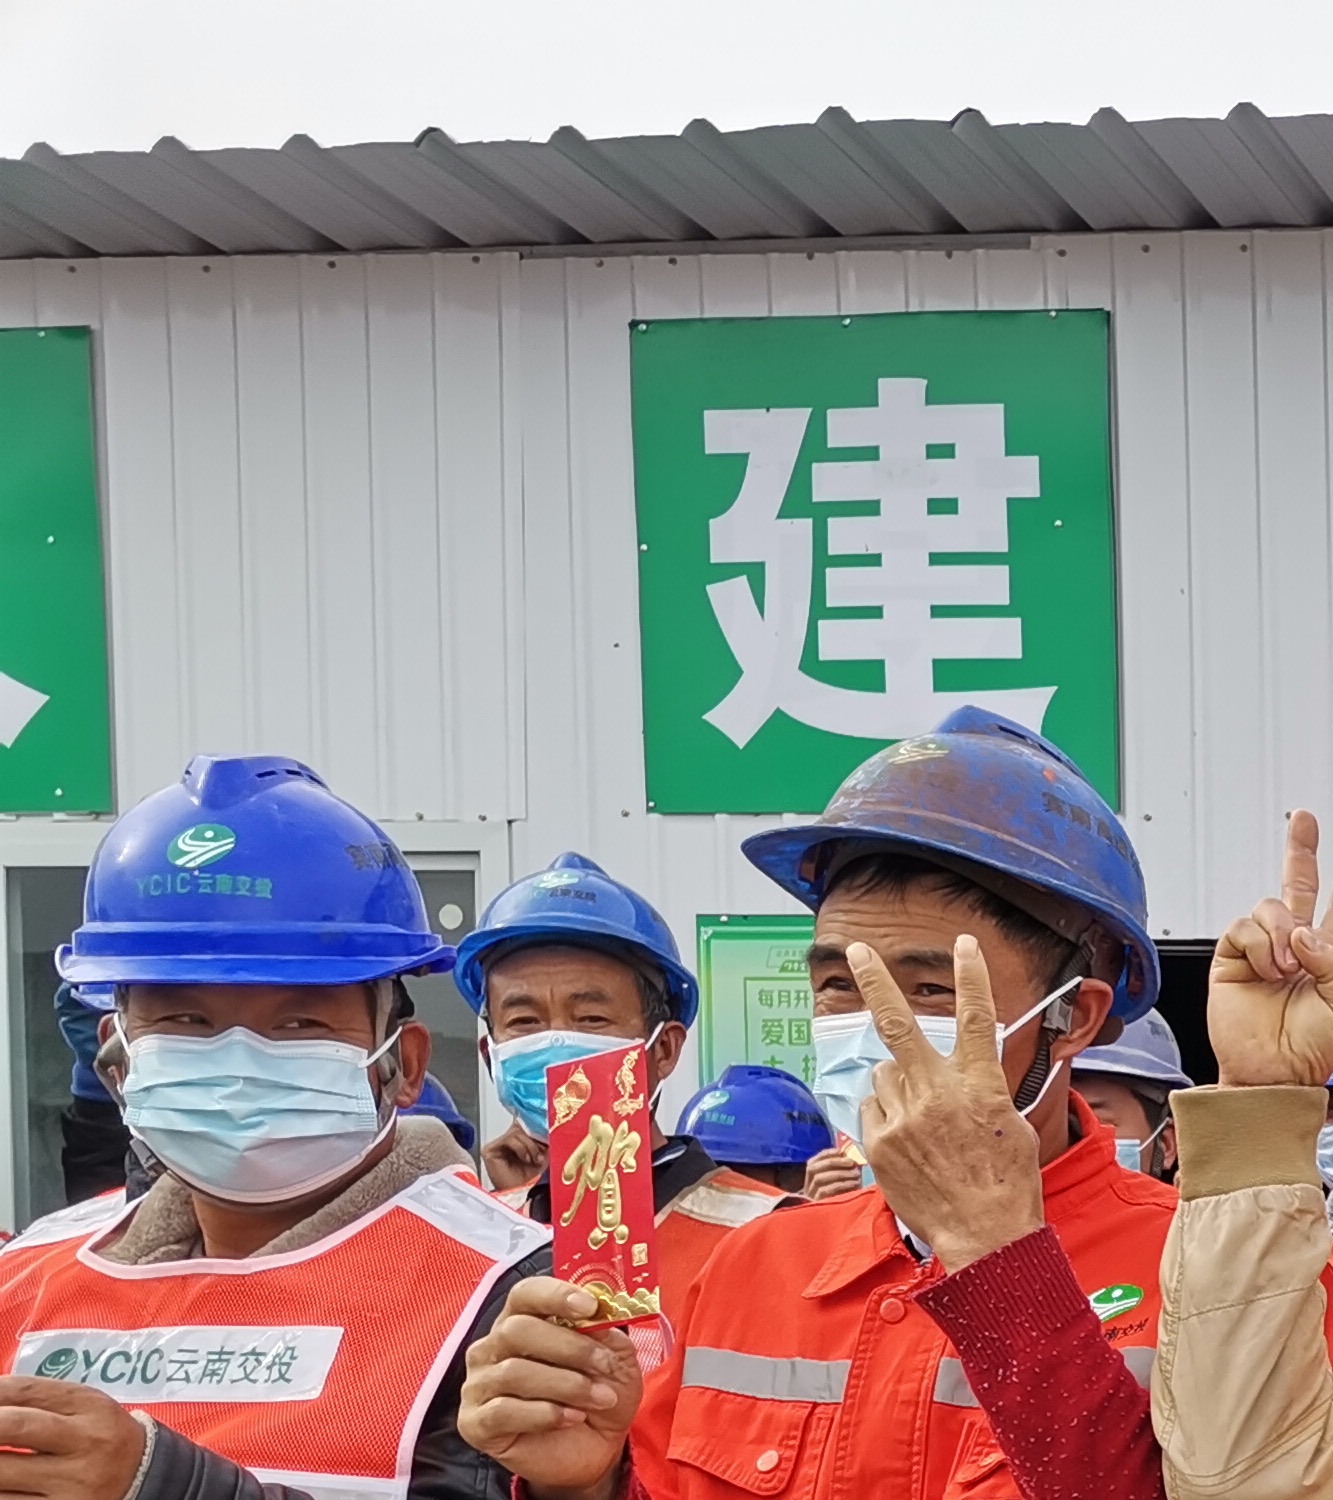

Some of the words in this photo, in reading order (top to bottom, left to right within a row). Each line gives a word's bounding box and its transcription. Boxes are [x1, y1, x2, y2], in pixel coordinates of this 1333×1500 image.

[701, 377, 1040, 749] 建
[80, 1345, 299, 1385] YCIC云南交投
